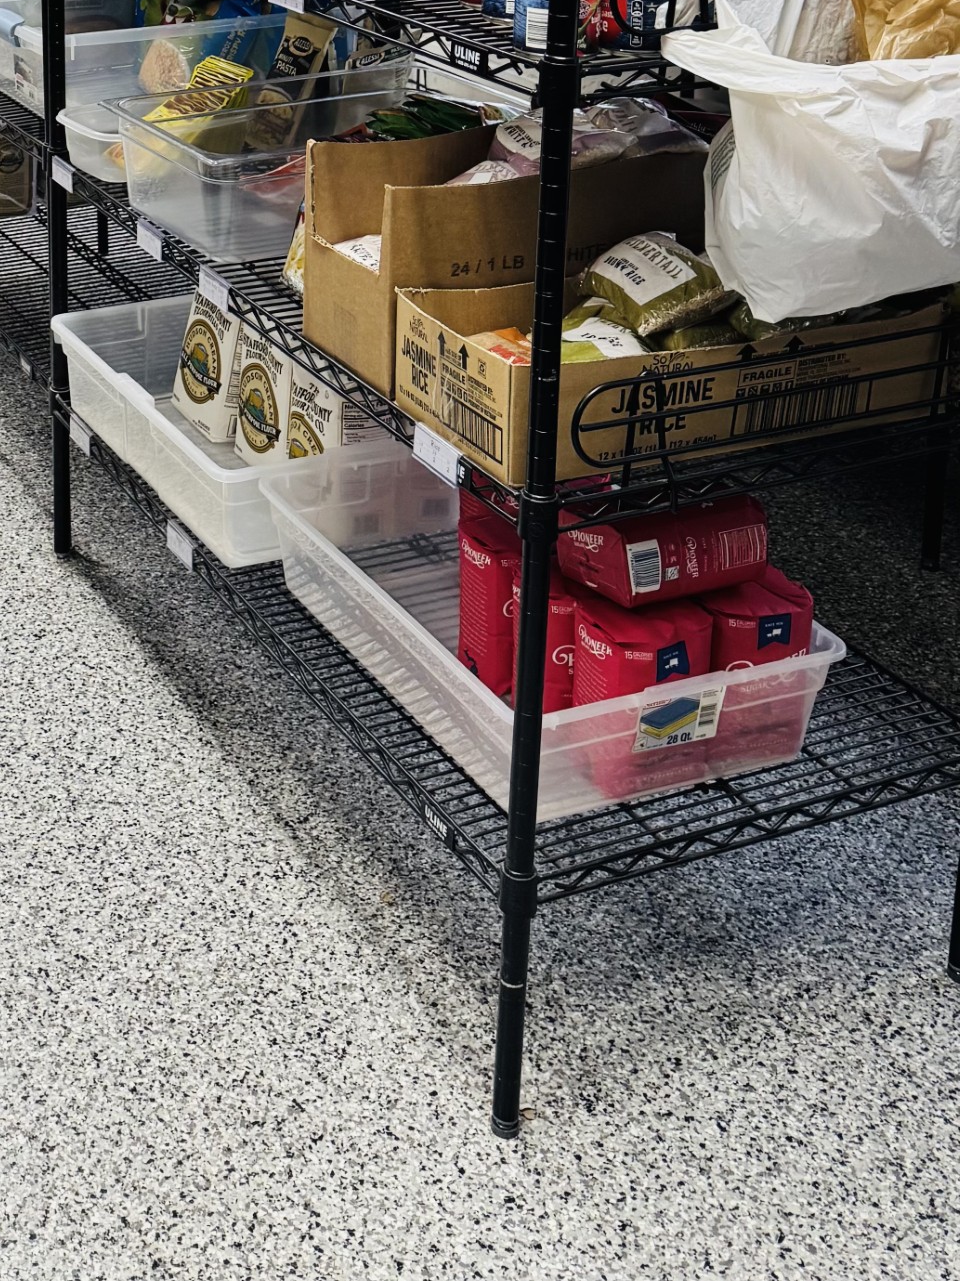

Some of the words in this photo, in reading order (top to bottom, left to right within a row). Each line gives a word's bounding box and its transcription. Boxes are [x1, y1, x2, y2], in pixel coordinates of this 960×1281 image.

[454, 44, 481, 65] ULINE
[276, 60, 297, 77] PASTA
[451, 261, 470, 277] 24
[502, 255, 525, 270] LB
[186, 326, 208, 350] HUDSON
[207, 330, 218, 376] CREAM
[401, 334, 437, 378] JASMINE
[653, 354, 666, 365] SO
[411, 363, 429, 395] RICE
[442, 363, 466, 386] FRAGILE
[742, 365, 792, 384] FRAGILE
[242, 372, 263, 397] HUDSON
[263, 378, 274, 421] CREAM
[567, 529, 604, 553] PIONEER
[461, 538, 492, 569] PIONEER
[501, 559, 508, 567] 15
[685, 536, 699, 579] PIONEER
[551, 605, 559, 614] 15
[578, 624, 613, 660] PIONEER
[741, 680, 768, 692] SUGAR
[666, 733, 680, 745] 28
[424, 803, 448, 838] ULINE
